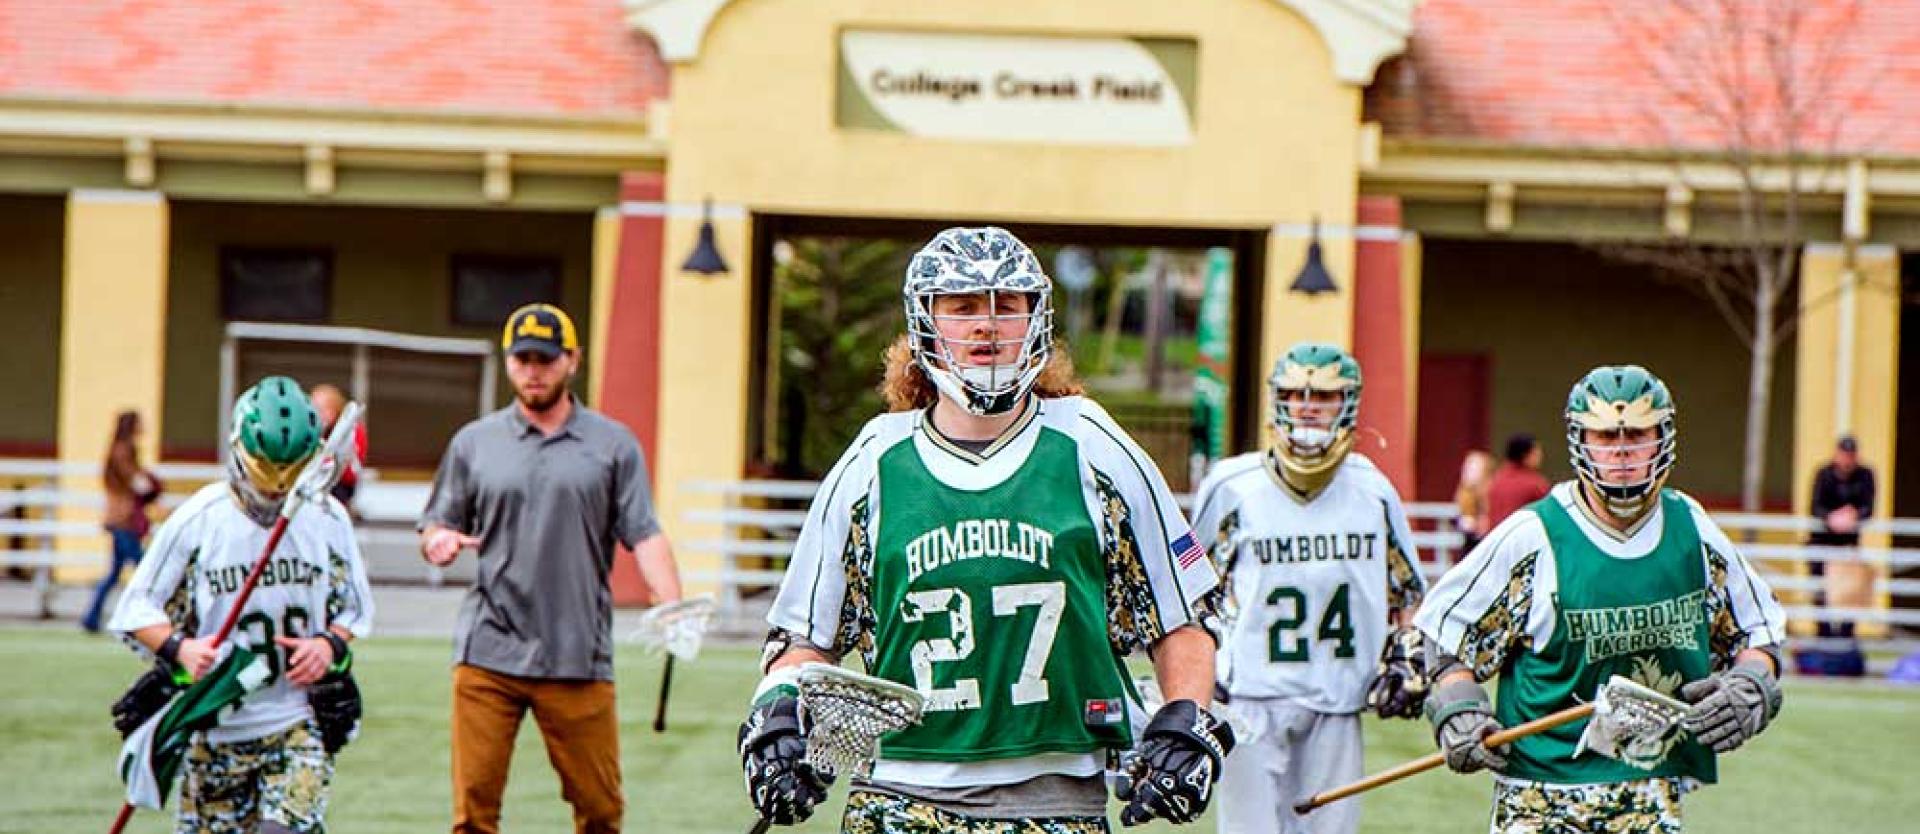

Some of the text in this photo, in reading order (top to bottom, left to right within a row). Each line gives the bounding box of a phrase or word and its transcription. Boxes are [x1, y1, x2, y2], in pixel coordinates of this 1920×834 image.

[871, 69, 1164, 102] College Creek Field
[905, 518, 1055, 584] HUMBOLDT
[1266, 583, 1356, 663] 24
[1564, 589, 1706, 642] HUMBOLDT
[1586, 623, 1699, 664] LACROSSE
[900, 581, 1066, 712] 27
